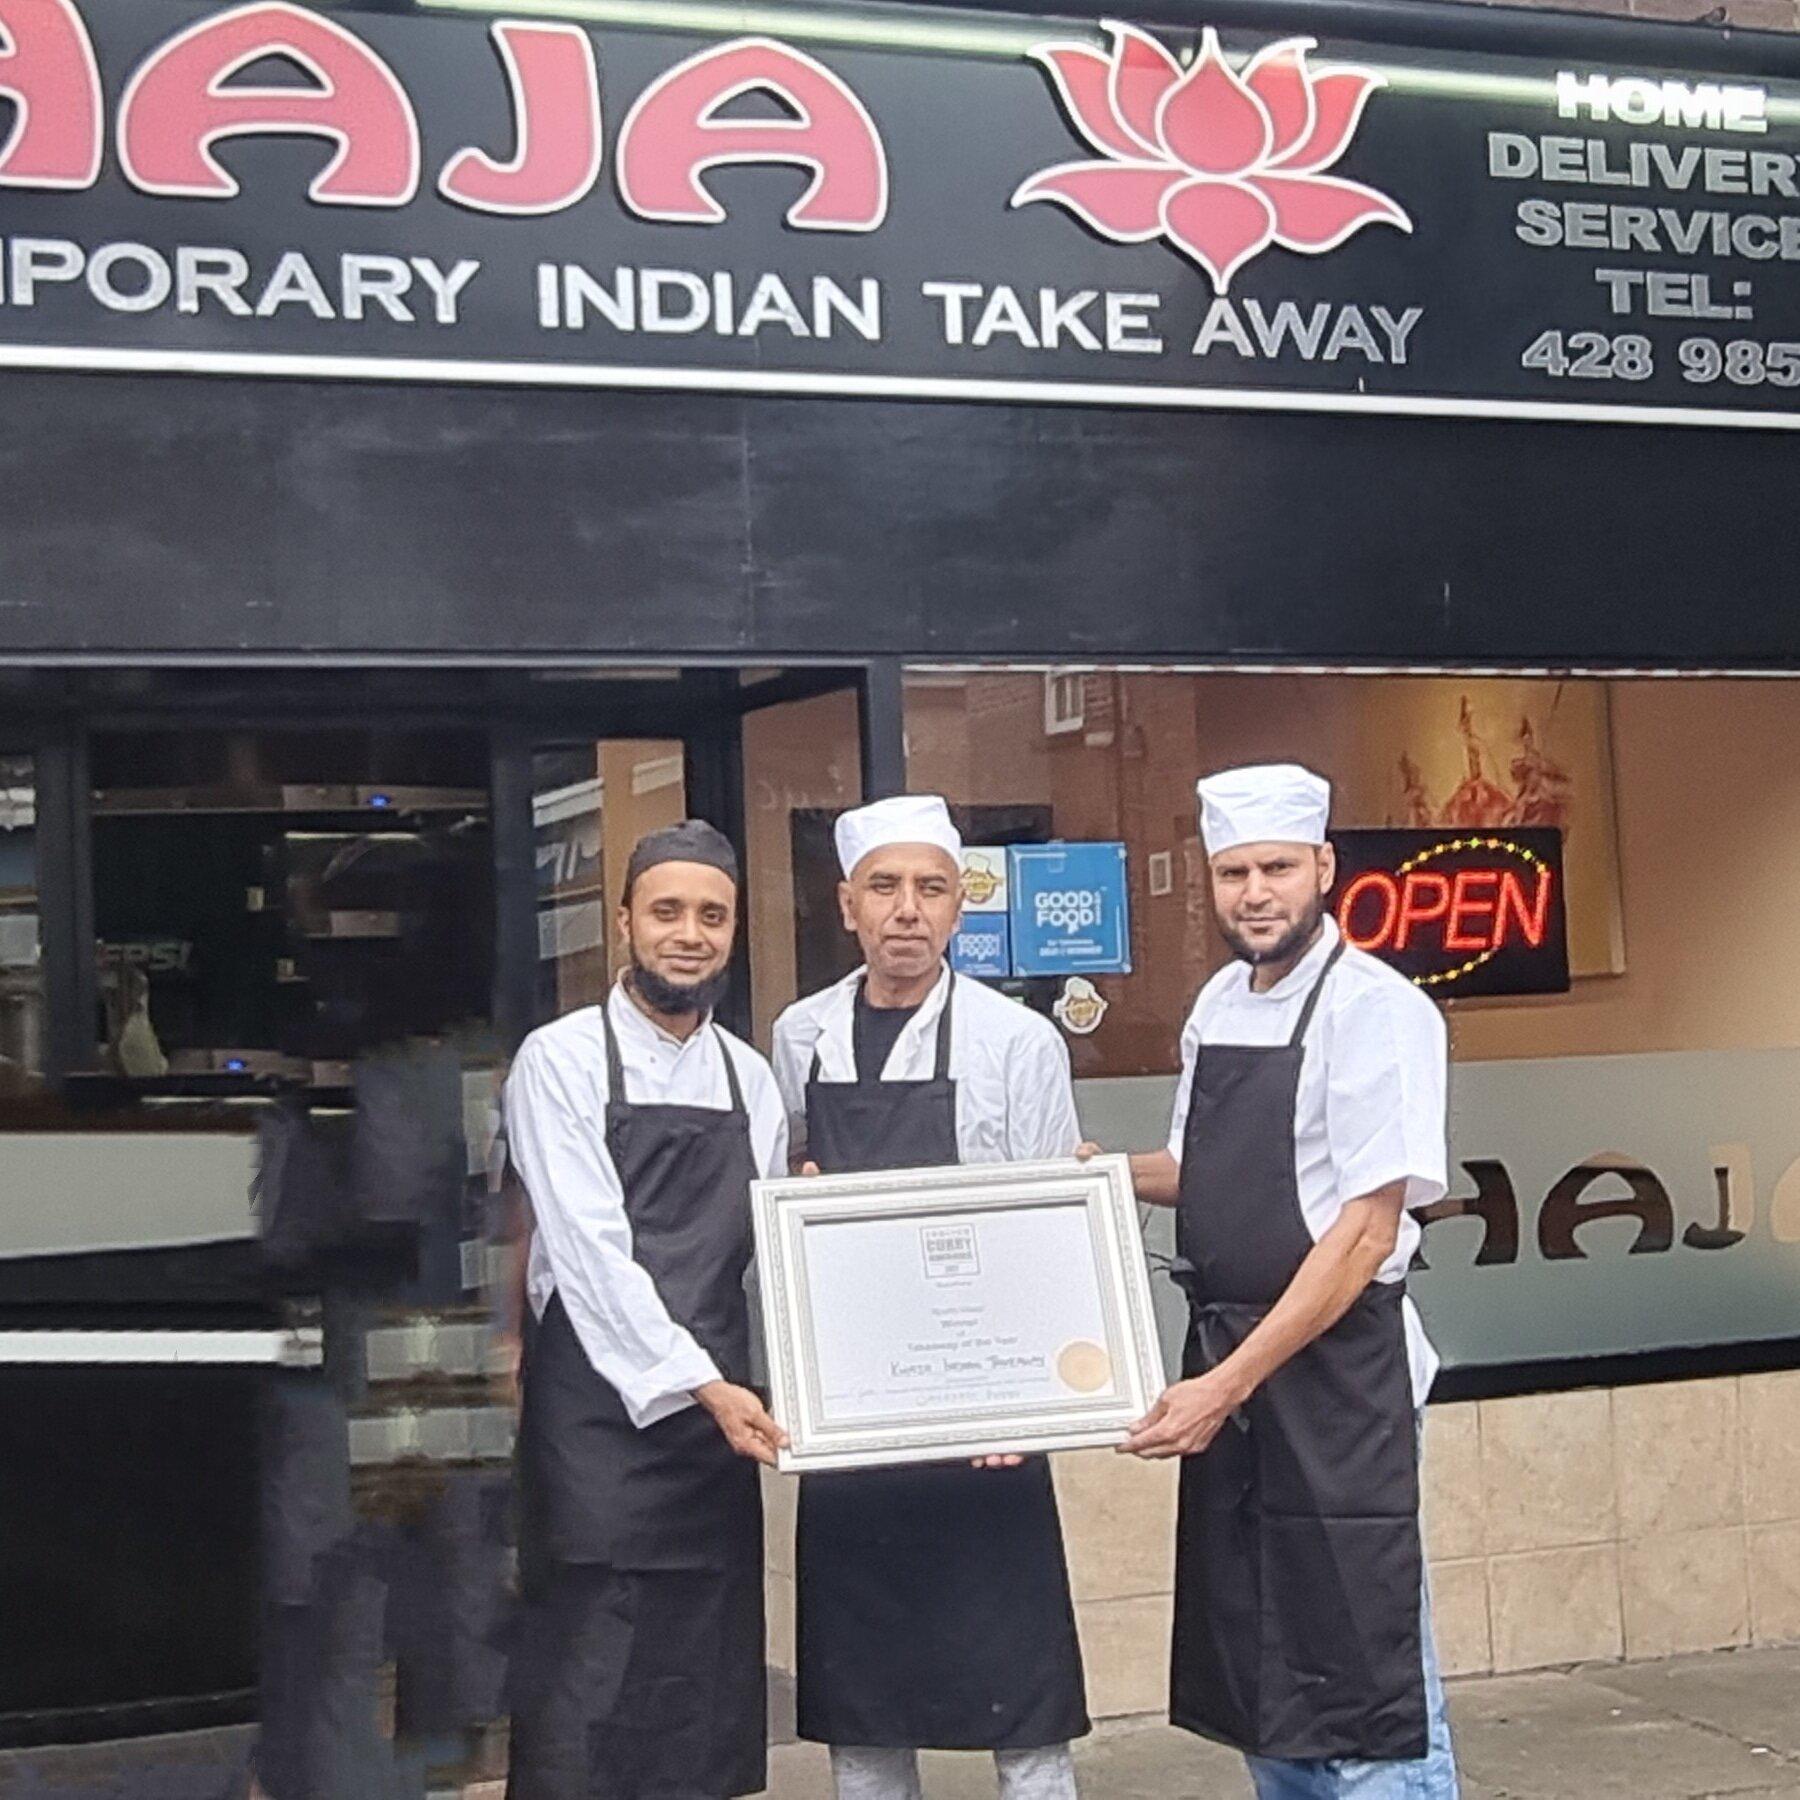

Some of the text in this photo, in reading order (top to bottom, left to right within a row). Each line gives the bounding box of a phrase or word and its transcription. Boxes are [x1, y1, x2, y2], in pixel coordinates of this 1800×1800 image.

[1556, 71, 1767, 133] HOME
[1488, 131, 1800, 197] DELIVER
[0, 236, 1424, 366] PORARY INDIAN TAKE AWAY
[1595, 267, 1753, 319] TEL:
[1522, 330, 1800, 387] 428 985
[1035, 890, 1093, 909] GOOD
[1036, 909, 1094, 929] FOOD
[1338, 869, 1552, 951] OPEN
